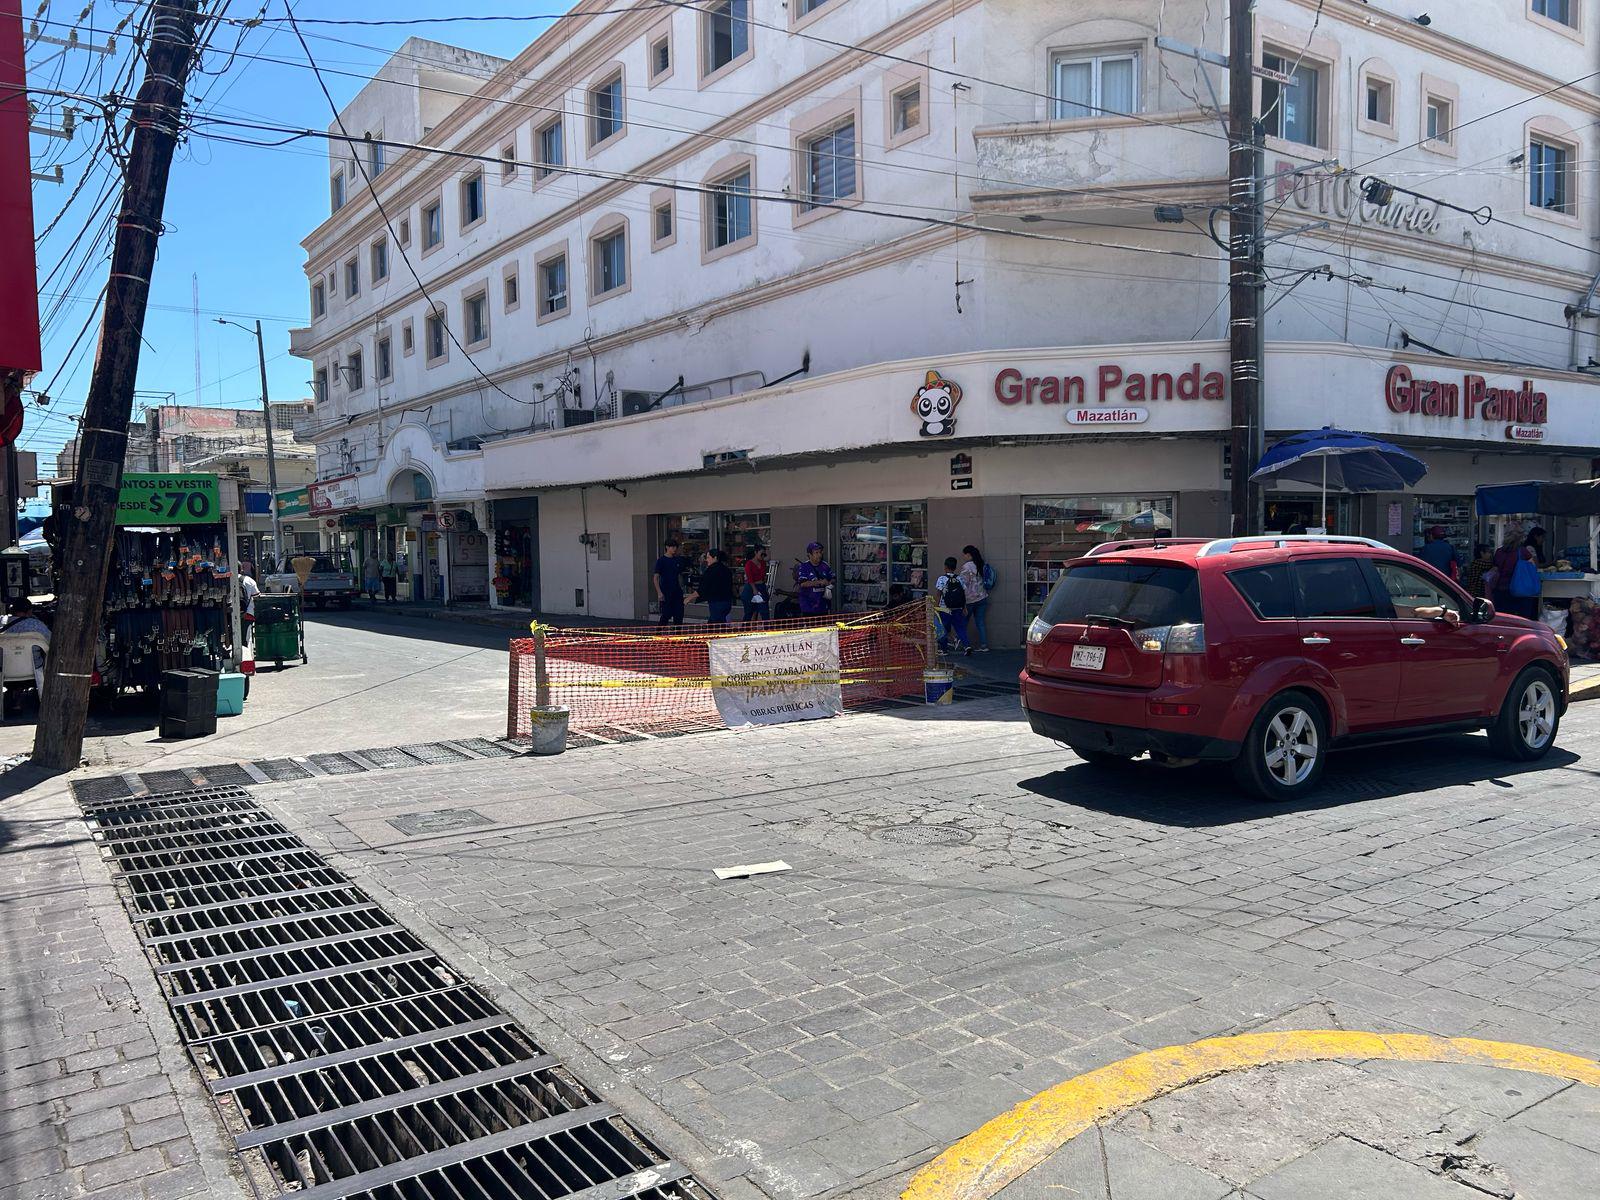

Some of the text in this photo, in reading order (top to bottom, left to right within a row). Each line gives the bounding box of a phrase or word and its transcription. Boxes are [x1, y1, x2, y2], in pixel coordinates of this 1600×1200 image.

[994, 362, 1225, 405] Gran Panda
[1385, 364, 1548, 424] Gran Panda
[1076, 409, 1138, 422] Mazatlán
[1515, 427, 1544, 440] Mazatlán
[158, 479, 172, 489] DE
[175, 479, 212, 489] VESTIR
[117, 491, 209, 519] ESDE $70
[754, 641, 814, 657] MAZATLÁN
[772, 662, 826, 676] TRABAJANDO
[750, 705, 777, 717] OBRAS
